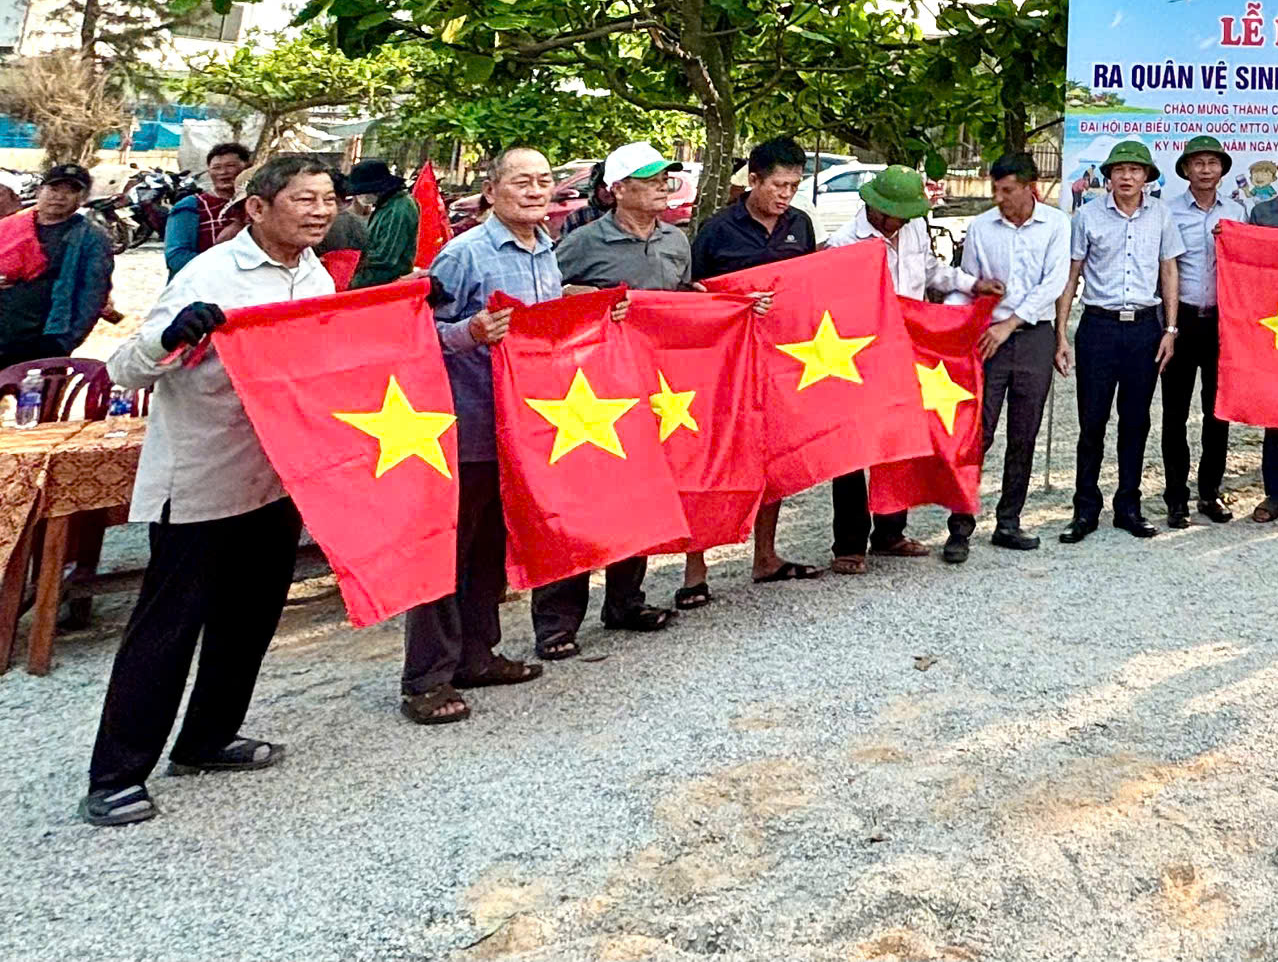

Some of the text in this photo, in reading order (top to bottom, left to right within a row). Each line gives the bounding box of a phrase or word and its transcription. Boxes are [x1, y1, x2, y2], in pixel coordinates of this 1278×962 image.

[1220, 2, 1265, 47] LỄ
[1093, 64, 1124, 89] RA
[1131, 59, 1194, 92] QUÂN
[1200, 60, 1228, 95] VỆ
[1164, 101, 1195, 115] CHÀO
[1102, 119, 1121, 134] HỘI
[1145, 117, 1171, 133] BIỂU
[1206, 118, 1237, 134] QUỐC
[1239, 123, 1270, 134] MTTQ
[1223, 139, 1246, 151] NĂM
